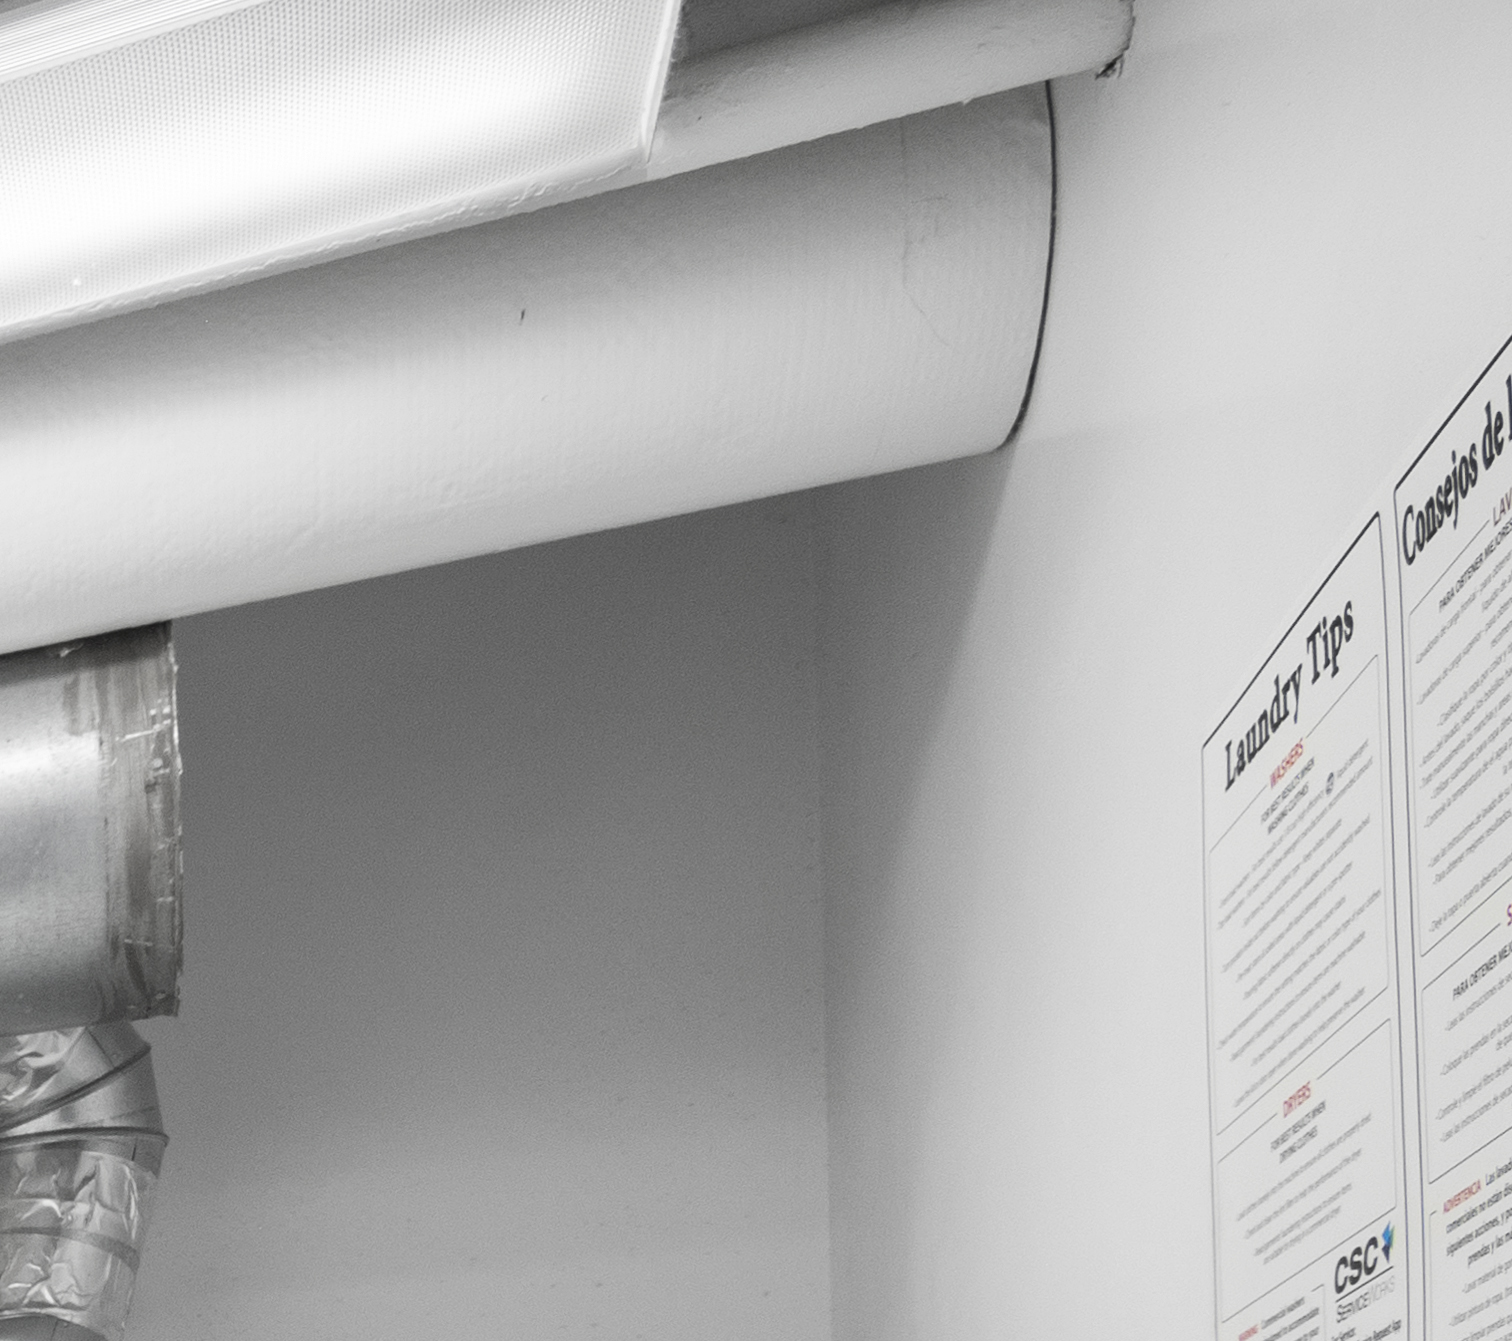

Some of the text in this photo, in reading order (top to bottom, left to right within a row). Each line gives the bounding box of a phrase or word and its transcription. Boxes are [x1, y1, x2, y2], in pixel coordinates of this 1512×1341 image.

[1402, 443, 1478, 565] Consejos
[1482, 400, 1505, 471] de
[1224, 600, 1355, 793] Laundry Tips
[1269, 737, 1304, 790] WASHERS
[1283, 1080, 1311, 1119] DRYERS
[1334, 1235, 1378, 1295] CSC
